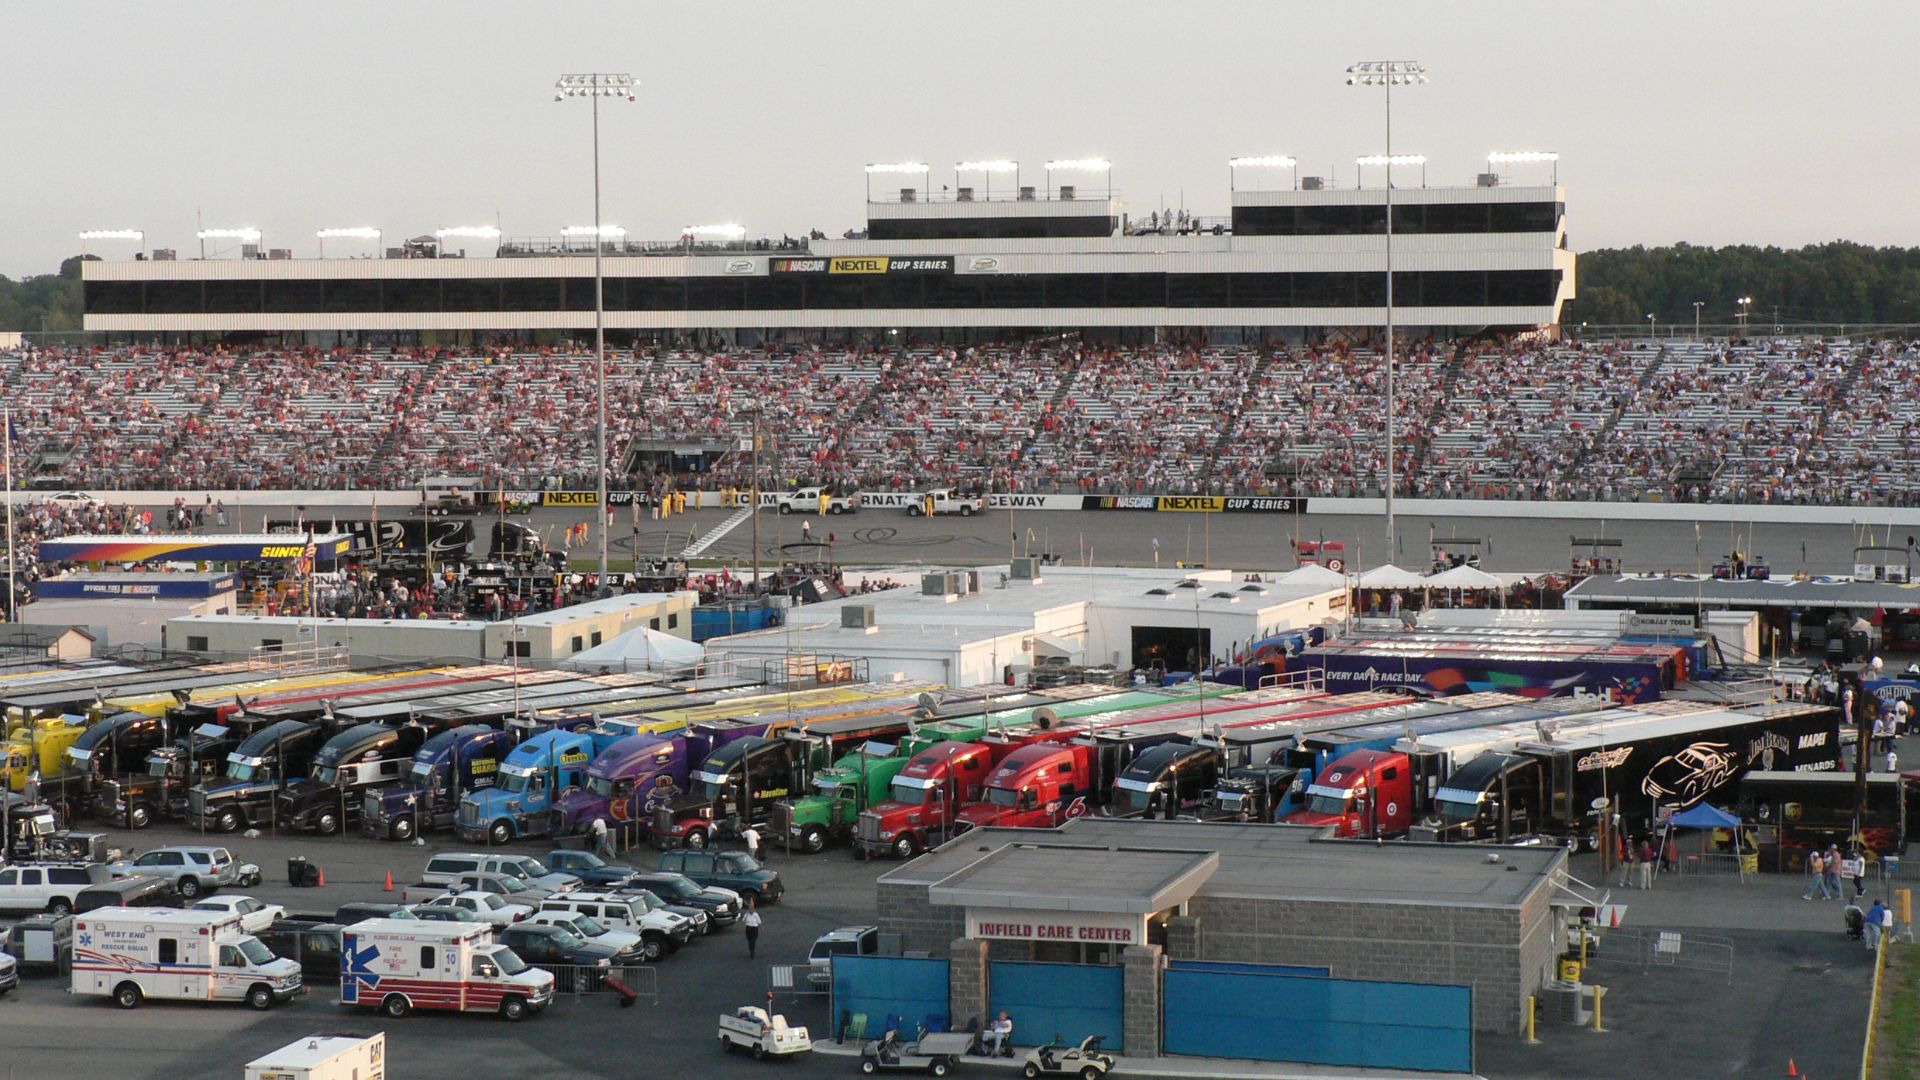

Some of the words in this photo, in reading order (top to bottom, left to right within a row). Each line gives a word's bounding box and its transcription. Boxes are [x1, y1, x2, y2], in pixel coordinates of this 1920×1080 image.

[790, 260, 825, 272] NASCAR
[836, 261, 881, 271] NEXTEL
[891, 261, 911, 270] CUP
[912, 261, 947, 270] SERIES
[504, 492, 538, 503] NASCAR
[609, 493, 631, 503] CUP
[1116, 496, 1154, 508] NASCAR
[1163, 497, 1219, 509] NEXTEL
[1227, 498, 1250, 509] CUP
[1252, 499, 1291, 510] SERIES
[1326, 671, 1352, 681] EVERY
[1353, 671, 1369, 681] DAY
[1381, 673, 1403, 682] RACE
[1404, 673, 1422, 683] DAY
[1764, 730, 1790, 756] BEAM
[1798, 732, 1828, 750] MAPEI
[471, 764, 497, 775] GUARD
[474, 777, 494, 785] GMAC
[1065, 796, 1087, 820] 6
[978, 922, 1033, 937] INFIELD
[1037, 924, 1074, 939] CARE
[1078, 926, 1132, 941] CENTER
[101, 943, 126, 951] RESCUE
[446, 953, 456, 965] 10
